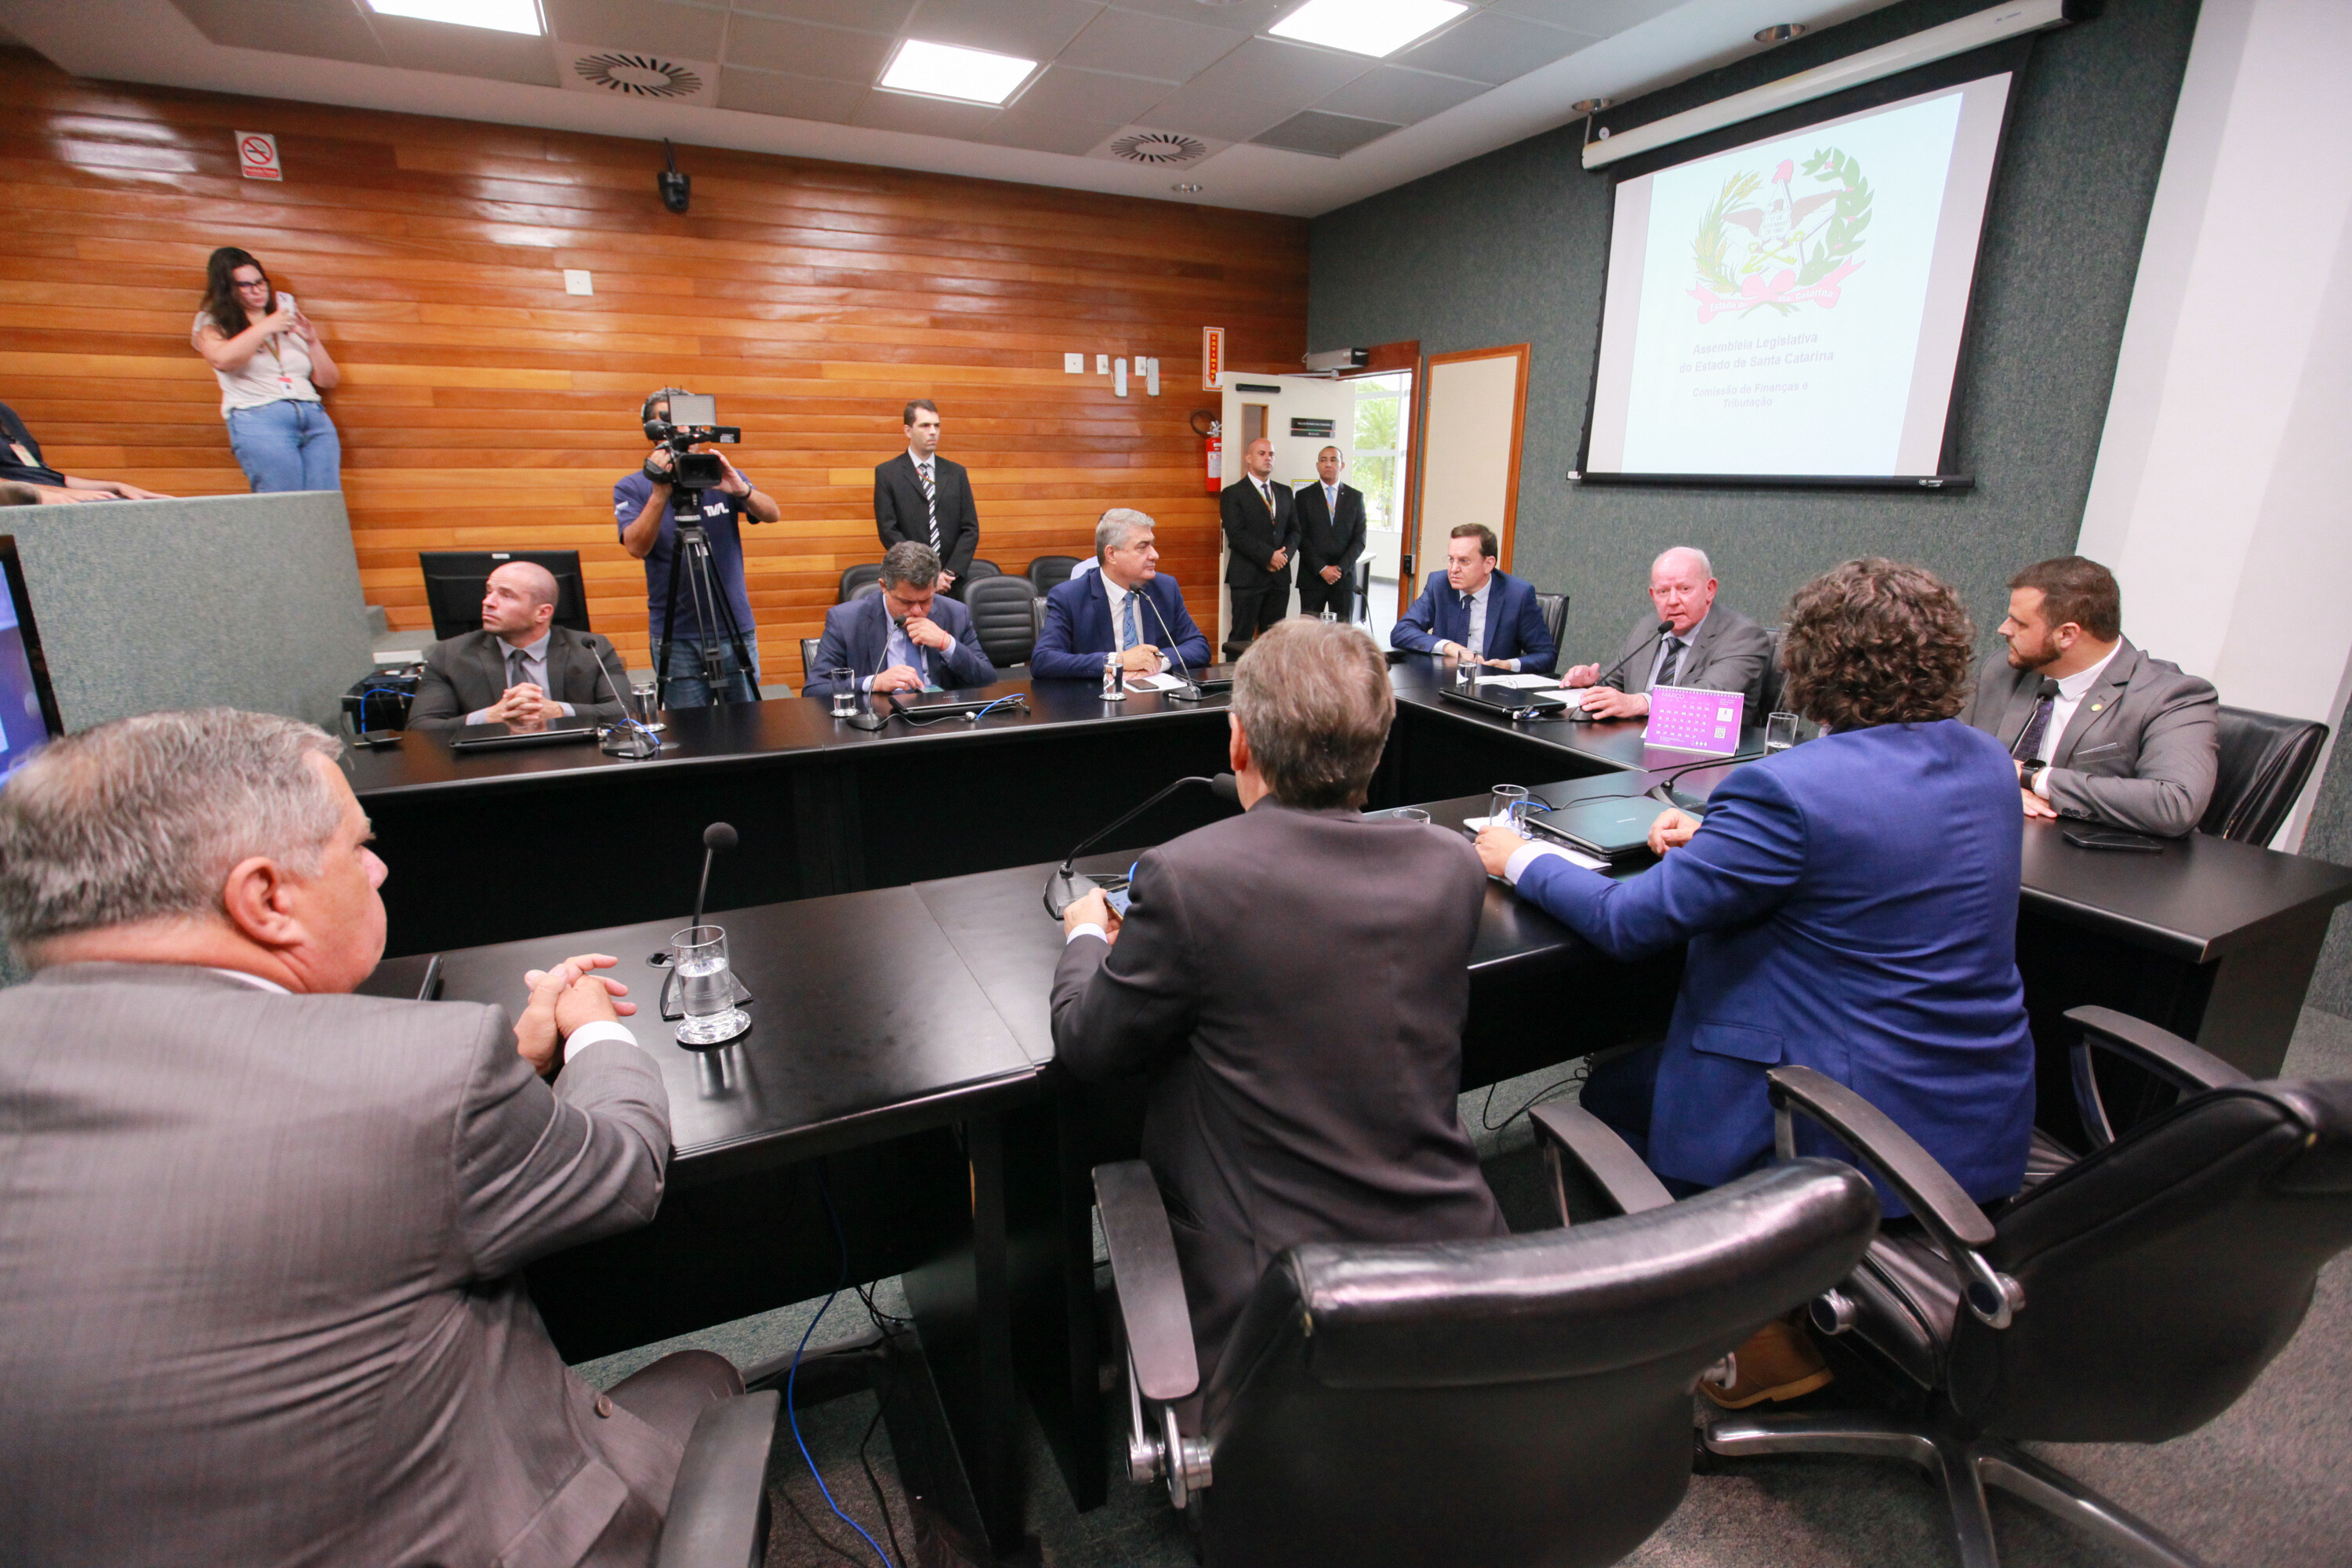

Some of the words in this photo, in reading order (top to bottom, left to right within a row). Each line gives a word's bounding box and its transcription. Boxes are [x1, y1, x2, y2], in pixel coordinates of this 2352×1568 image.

[1709, 302, 1737, 312] Estado
[1692, 339, 1752, 355] Assembleia
[1756, 332, 1818, 350] Legislativa
[1679, 361, 1692, 373] do
[1695, 359, 1730, 372] Estado
[1733, 358, 1747, 368] de
[1749, 355, 1781, 368] Santa
[1784, 350, 1835, 365] Catarina
[1692, 385, 1737, 397] Comissão
[1740, 384, 1751, 394] de
[1754, 382, 1799, 394] Finanças
[1722, 396, 1773, 409] Tributação
[1661, 691, 1684, 700] MARÇO
